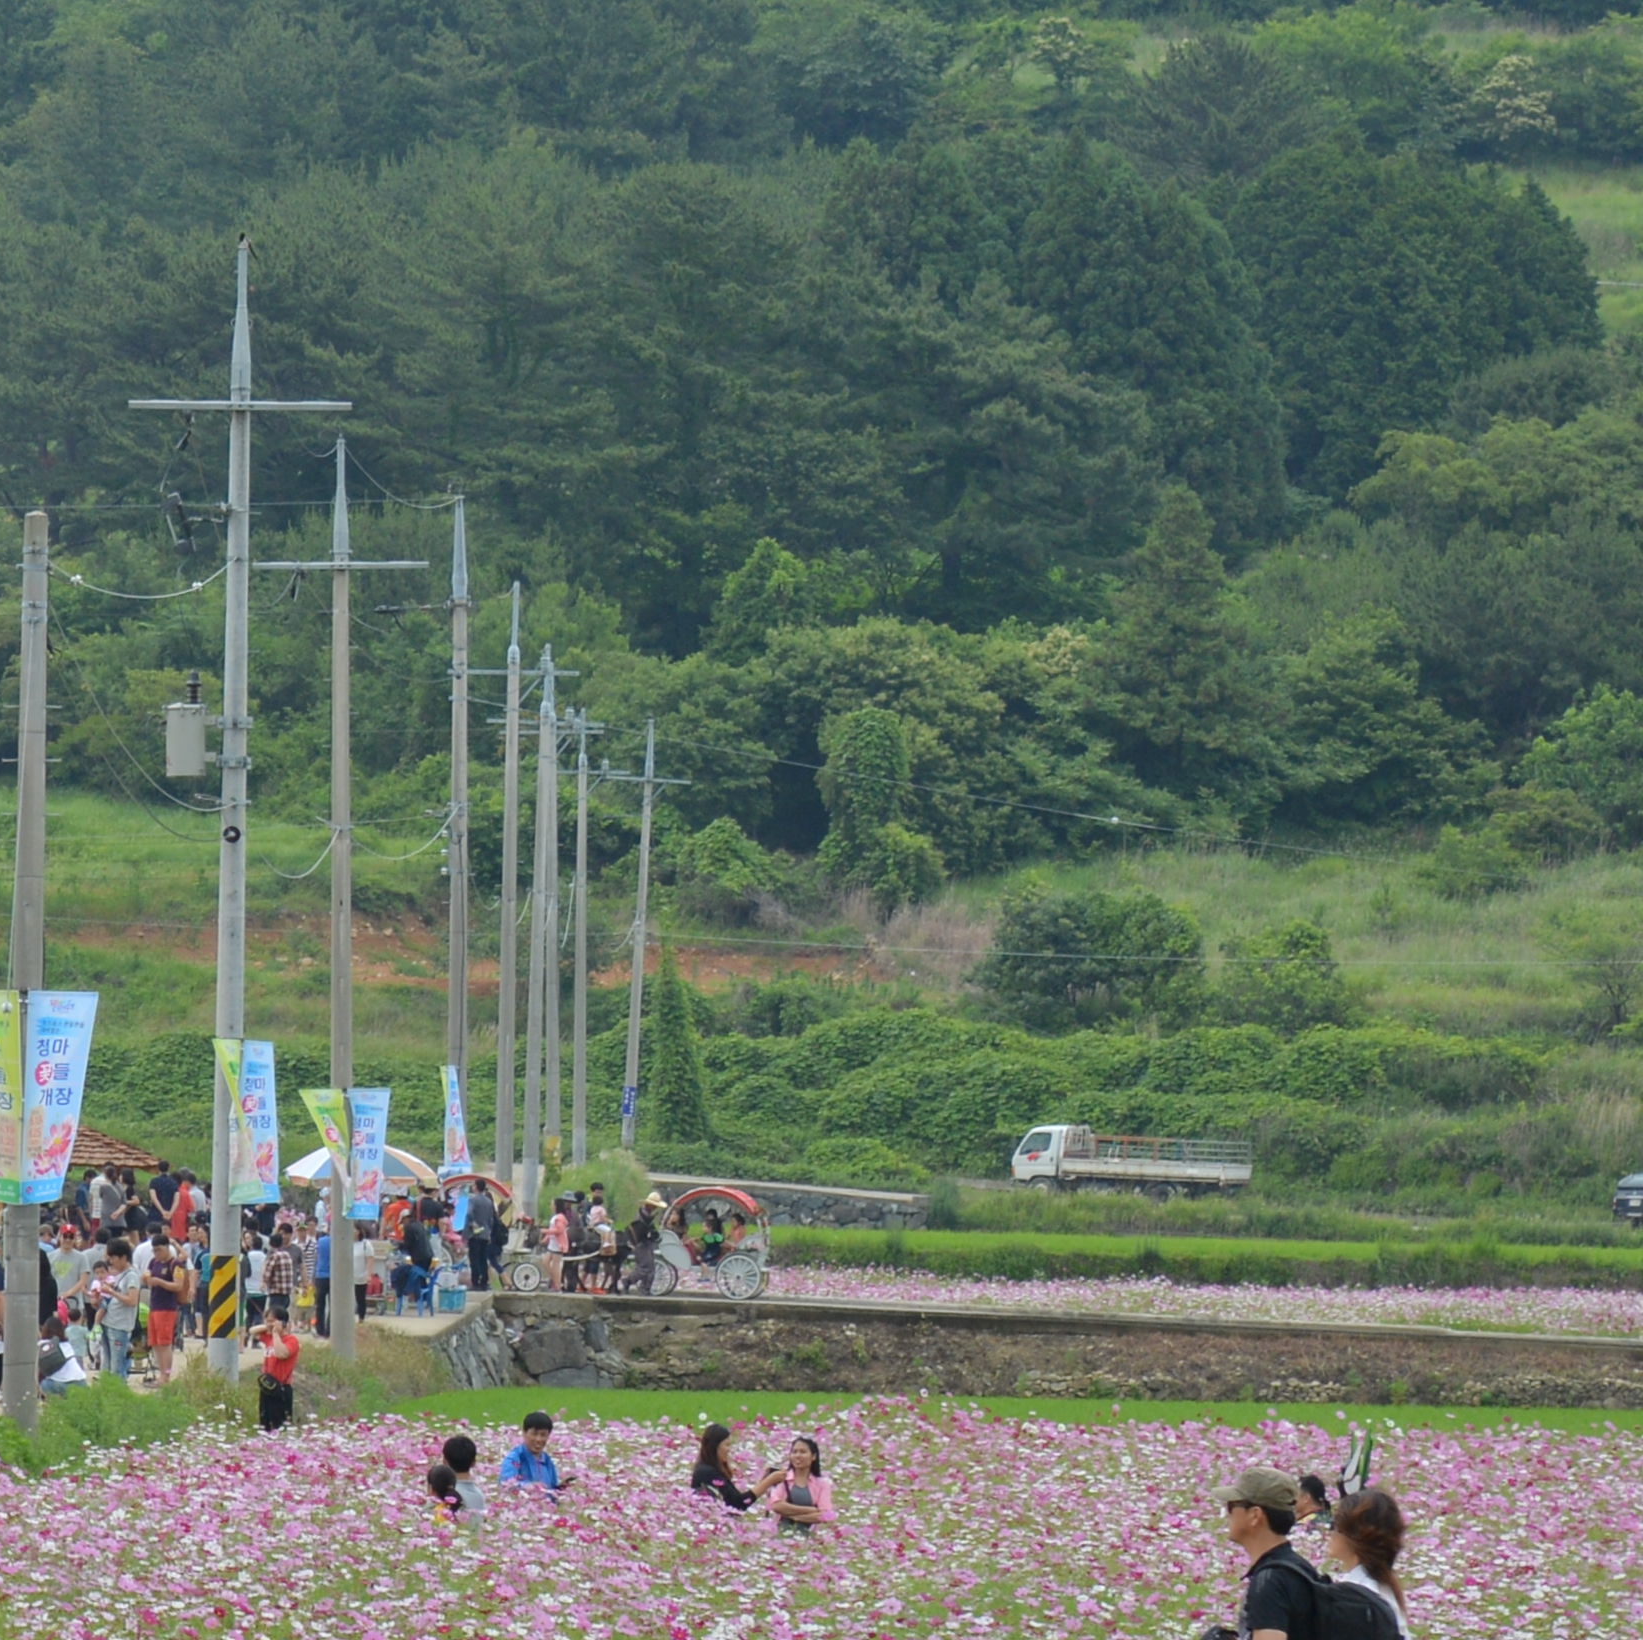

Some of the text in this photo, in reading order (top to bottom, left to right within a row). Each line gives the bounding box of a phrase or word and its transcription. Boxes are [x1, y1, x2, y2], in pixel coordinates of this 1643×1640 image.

[37, 1038, 70, 1058] 청마
[38, 1061, 70, 1083] 꽃들
[39, 1087, 73, 1107] 개장
